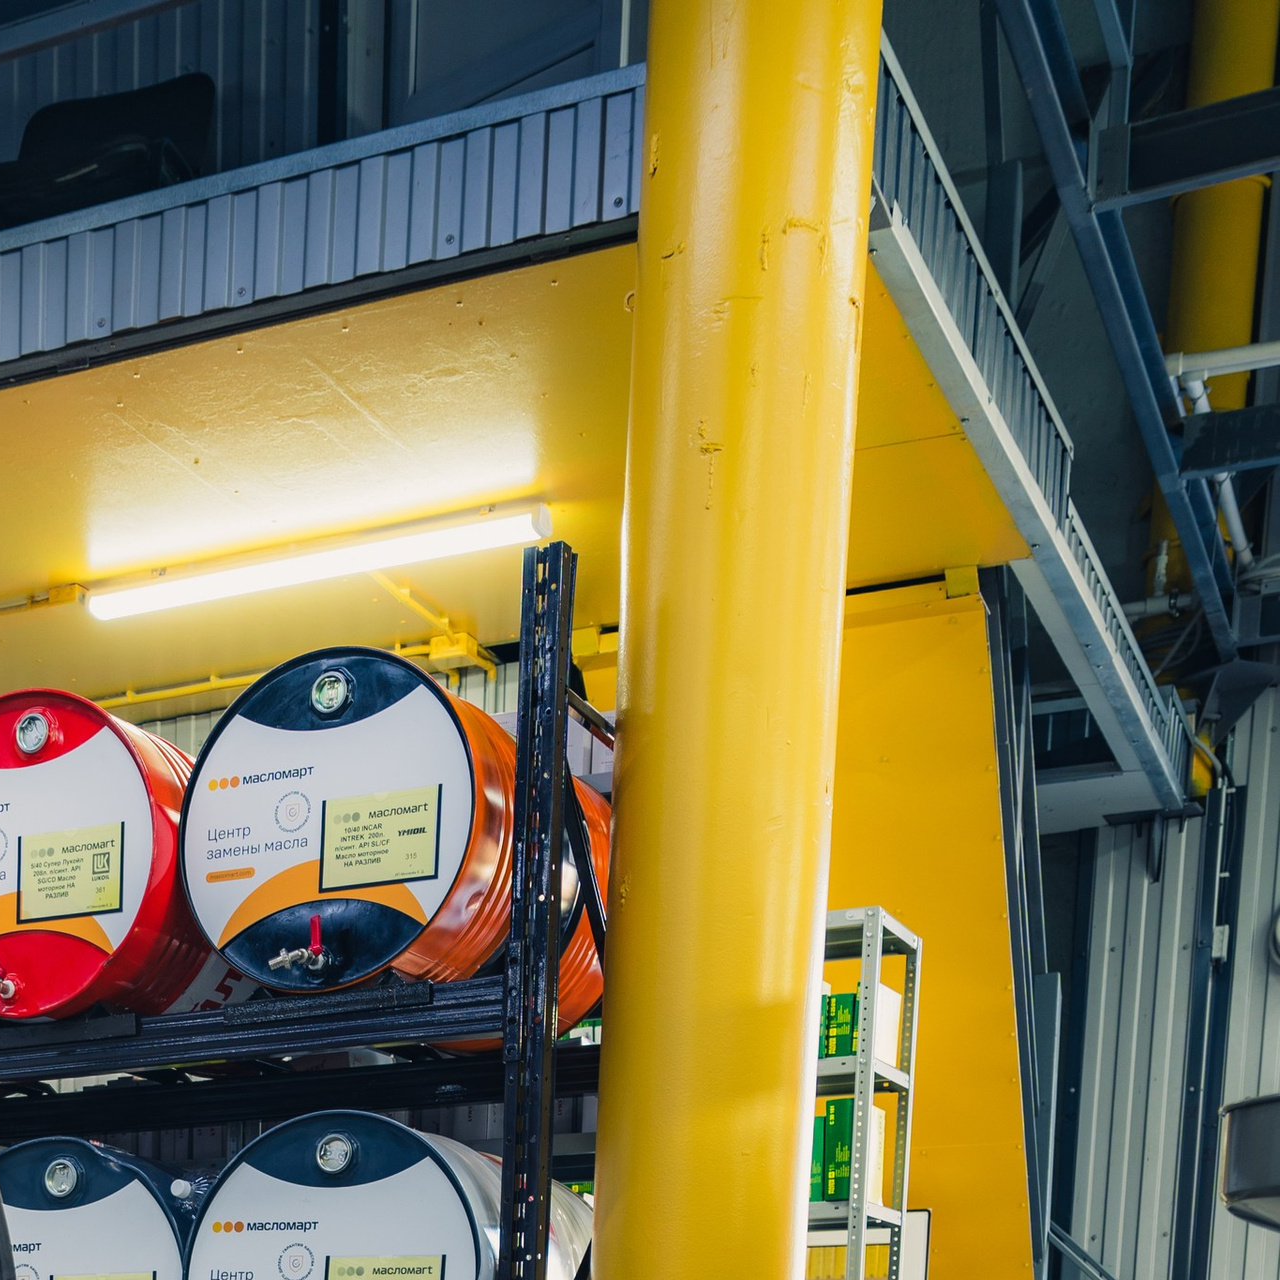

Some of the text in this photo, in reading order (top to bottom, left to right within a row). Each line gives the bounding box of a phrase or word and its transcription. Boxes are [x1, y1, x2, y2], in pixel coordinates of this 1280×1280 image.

[242, 766, 315, 785] масломарт
[344, 823, 382, 834] 10/40 INCAR
[207, 826, 251, 842] Центр
[340, 834, 364, 842] INTREK
[371, 839, 390, 847] SL/CF
[206, 837, 308, 860] замены масла
[357, 848, 389, 857] моторное
[405, 852, 417, 860] 315
[43, 860, 61, 868] Супер
[355, 857, 381, 866] РАЗЛИВ
[45, 891, 69, 899] РАЗЛИВ
[246, 1221, 319, 1232] масломарт
